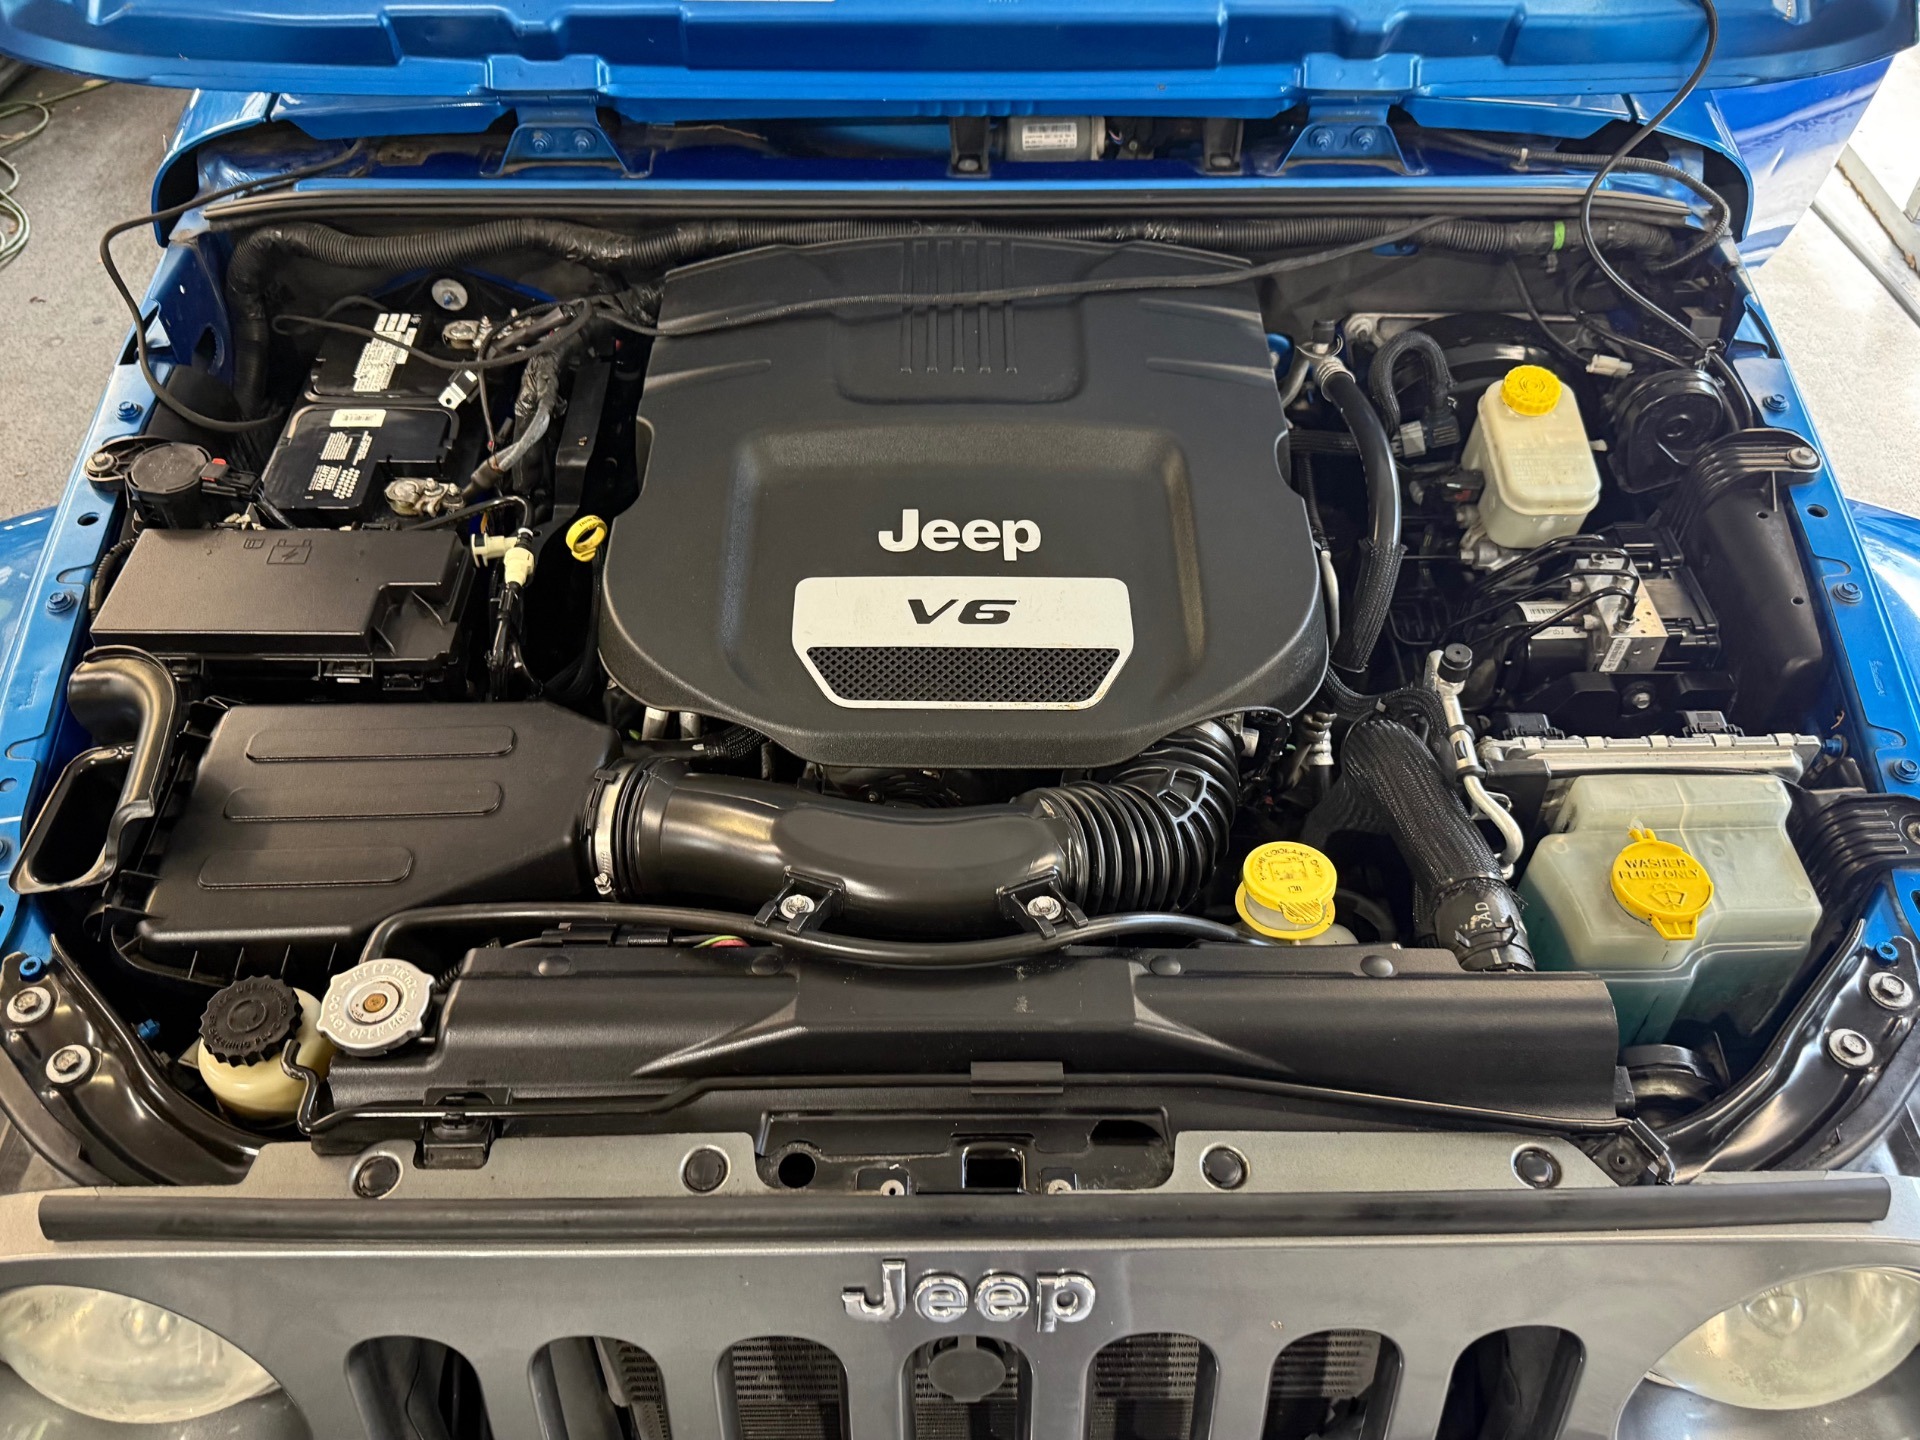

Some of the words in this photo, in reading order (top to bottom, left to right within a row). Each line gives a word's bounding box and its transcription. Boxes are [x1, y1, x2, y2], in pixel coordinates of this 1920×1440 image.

[877, 508, 1043, 562] Jeep
[906, 598, 1019, 625] V6
[1618, 870, 1660, 880] FLUID
[1663, 869, 1700, 879] ONLY
[1624, 858, 1687, 870] WASHER
[841, 1259, 1097, 1333] Jeep
